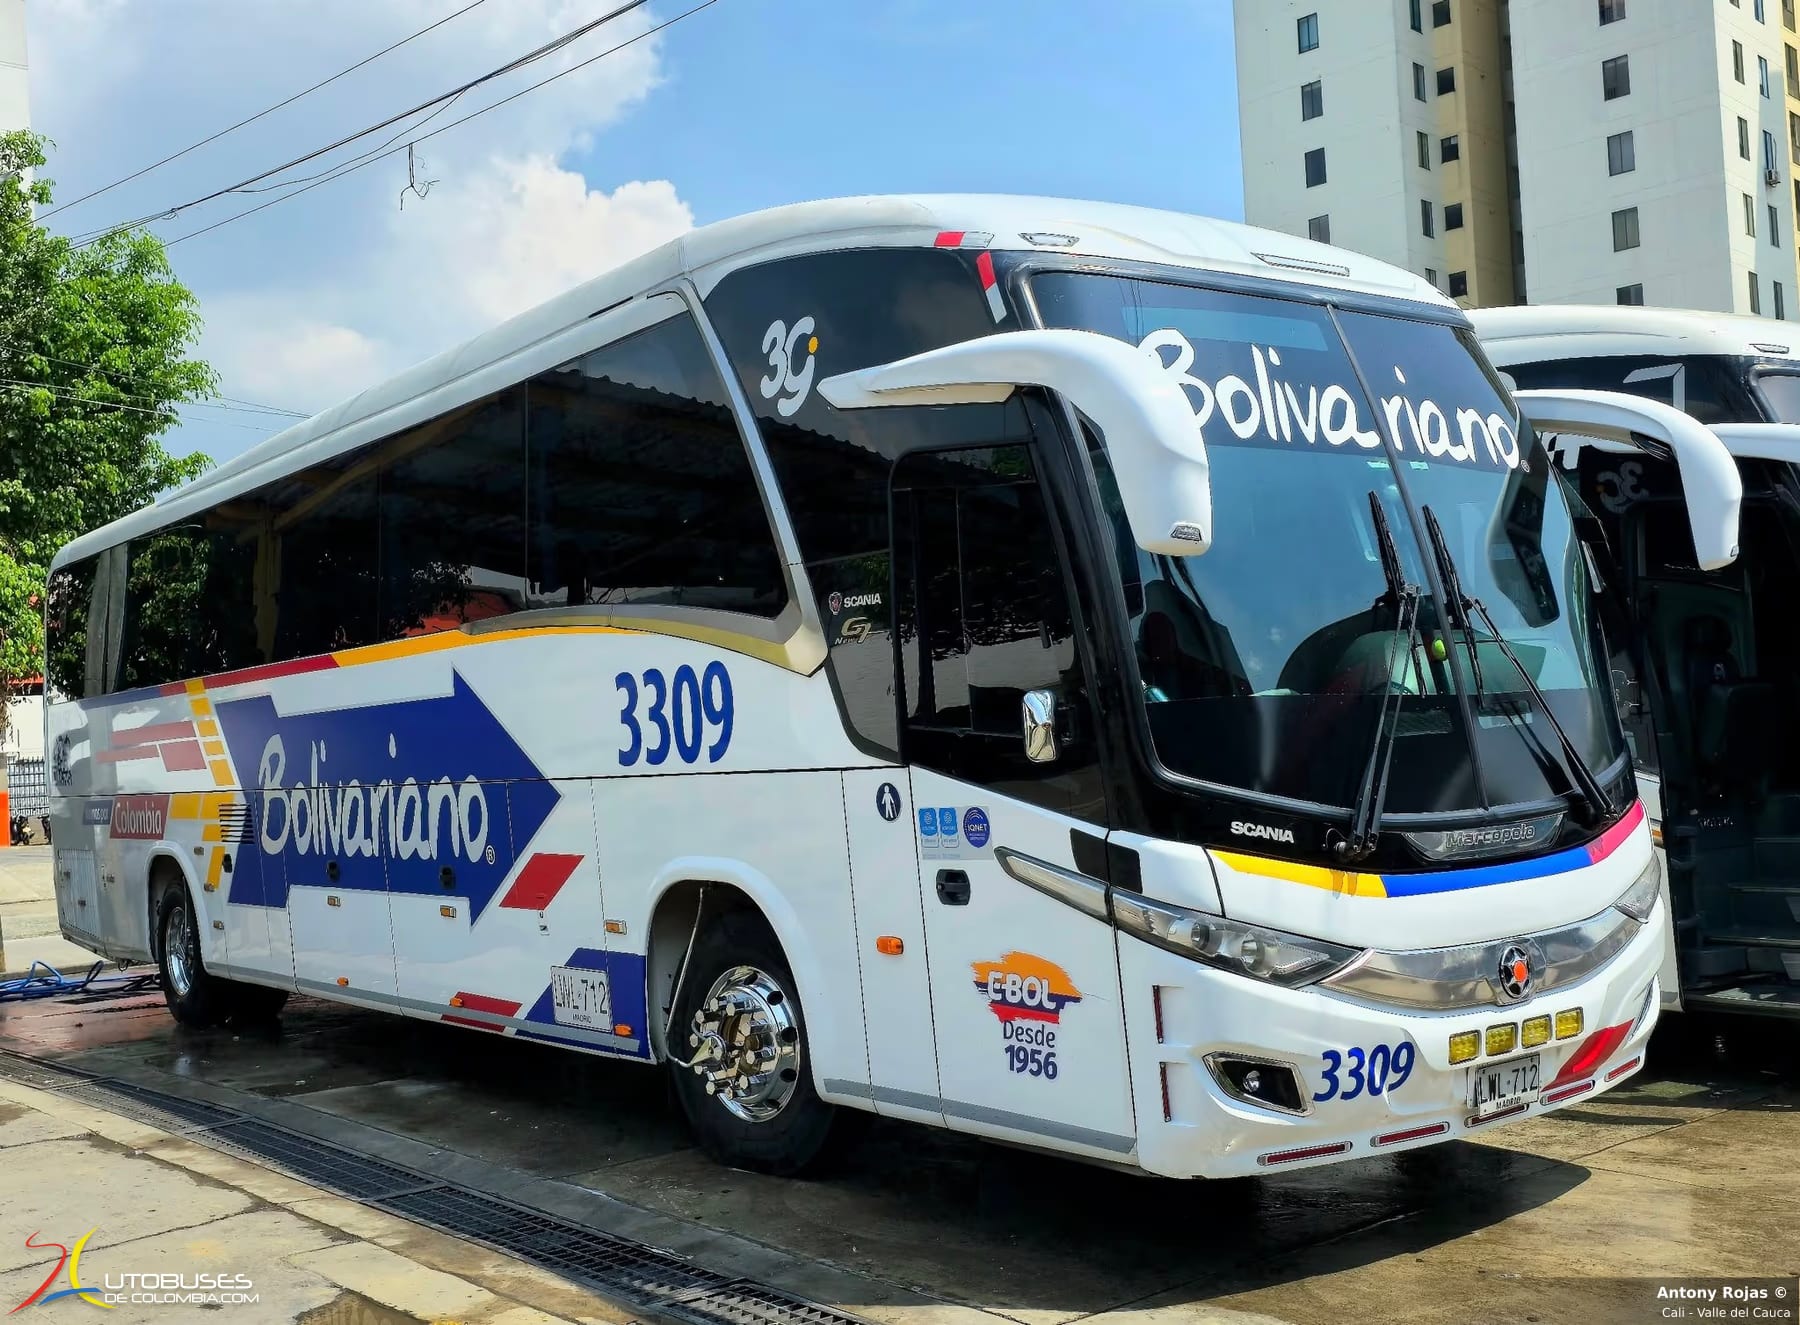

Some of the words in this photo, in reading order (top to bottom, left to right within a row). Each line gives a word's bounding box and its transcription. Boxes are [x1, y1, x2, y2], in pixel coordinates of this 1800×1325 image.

[843, 593, 882, 608] SCANIA
[615, 660, 734, 767] 3309
[258, 733, 489, 863] Bolivariano
[115, 801, 162, 834] Colombia
[1230, 821, 1295, 844] SCANIA
[1445, 823, 1536, 849] Marcopolo
[1003, 1020, 1056, 1048] Desde
[1004, 1044, 1058, 1080] 1956
[1312, 1041, 1416, 1102] 3309
